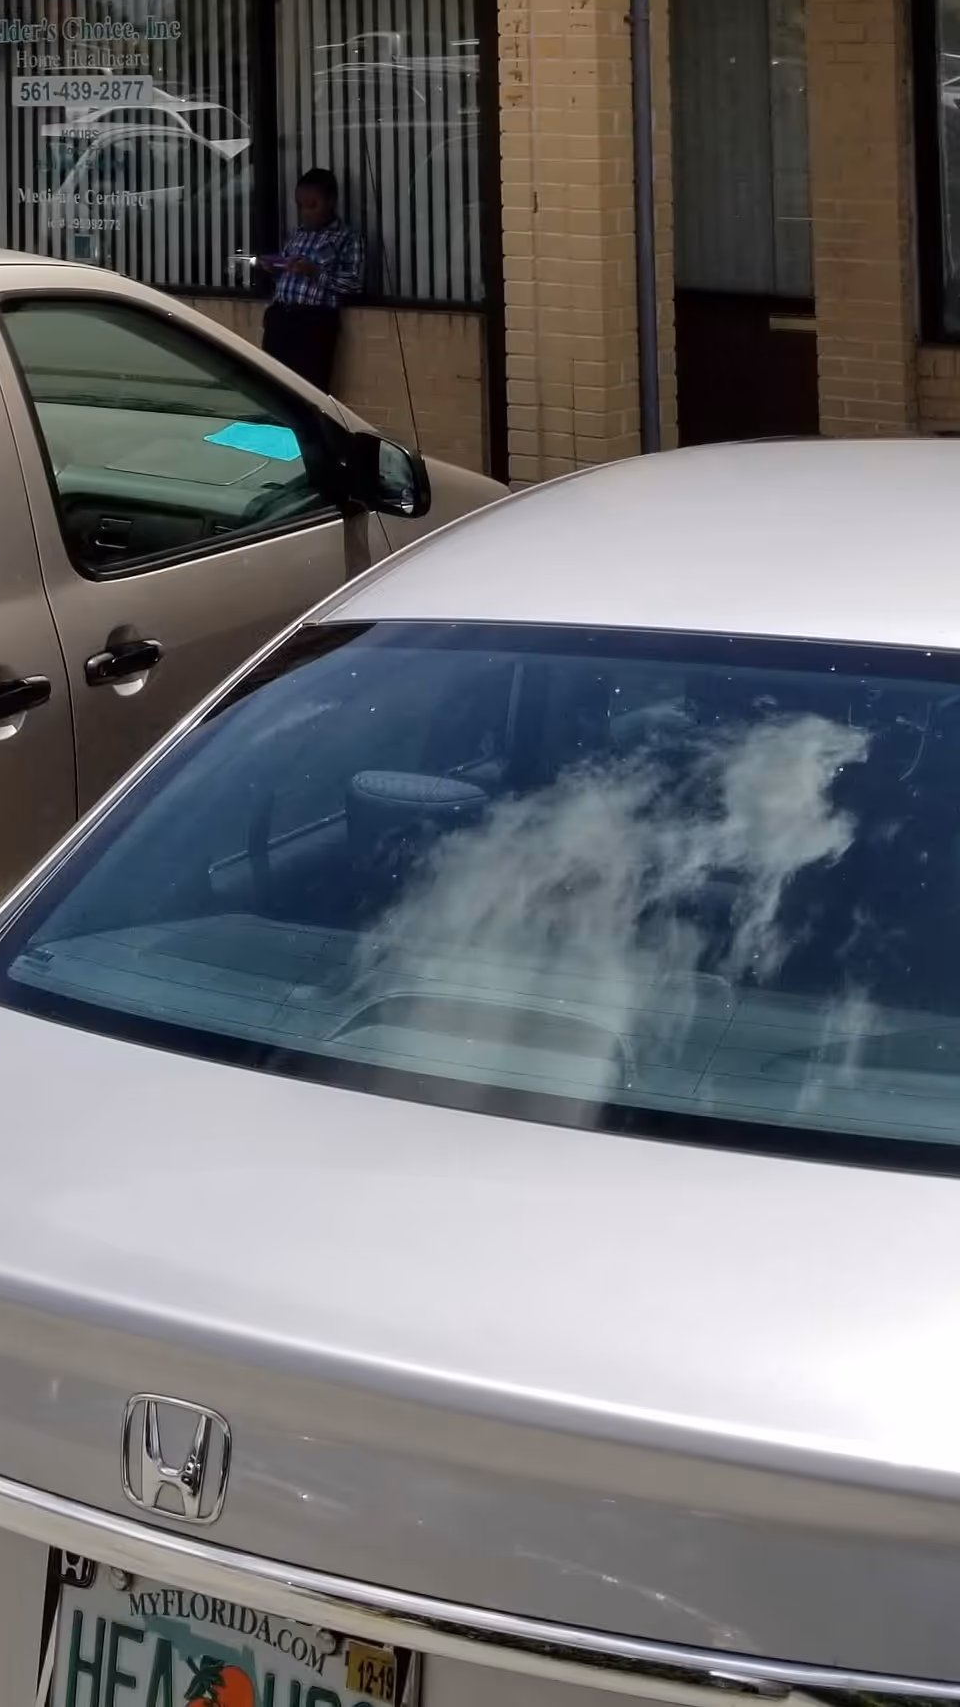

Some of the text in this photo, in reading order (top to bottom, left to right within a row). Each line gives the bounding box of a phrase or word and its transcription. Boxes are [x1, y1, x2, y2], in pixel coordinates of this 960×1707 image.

[62, 16, 139, 42] Choice,
[144, 14, 182, 40] Inc
[16, 47, 150, 68] Home Healthcare
[20, 80, 144, 101] 561-439-2877
[128, 1588, 327, 1677] MYFLORIDA.COM
[358, 1659, 394, 1700] 12-19
